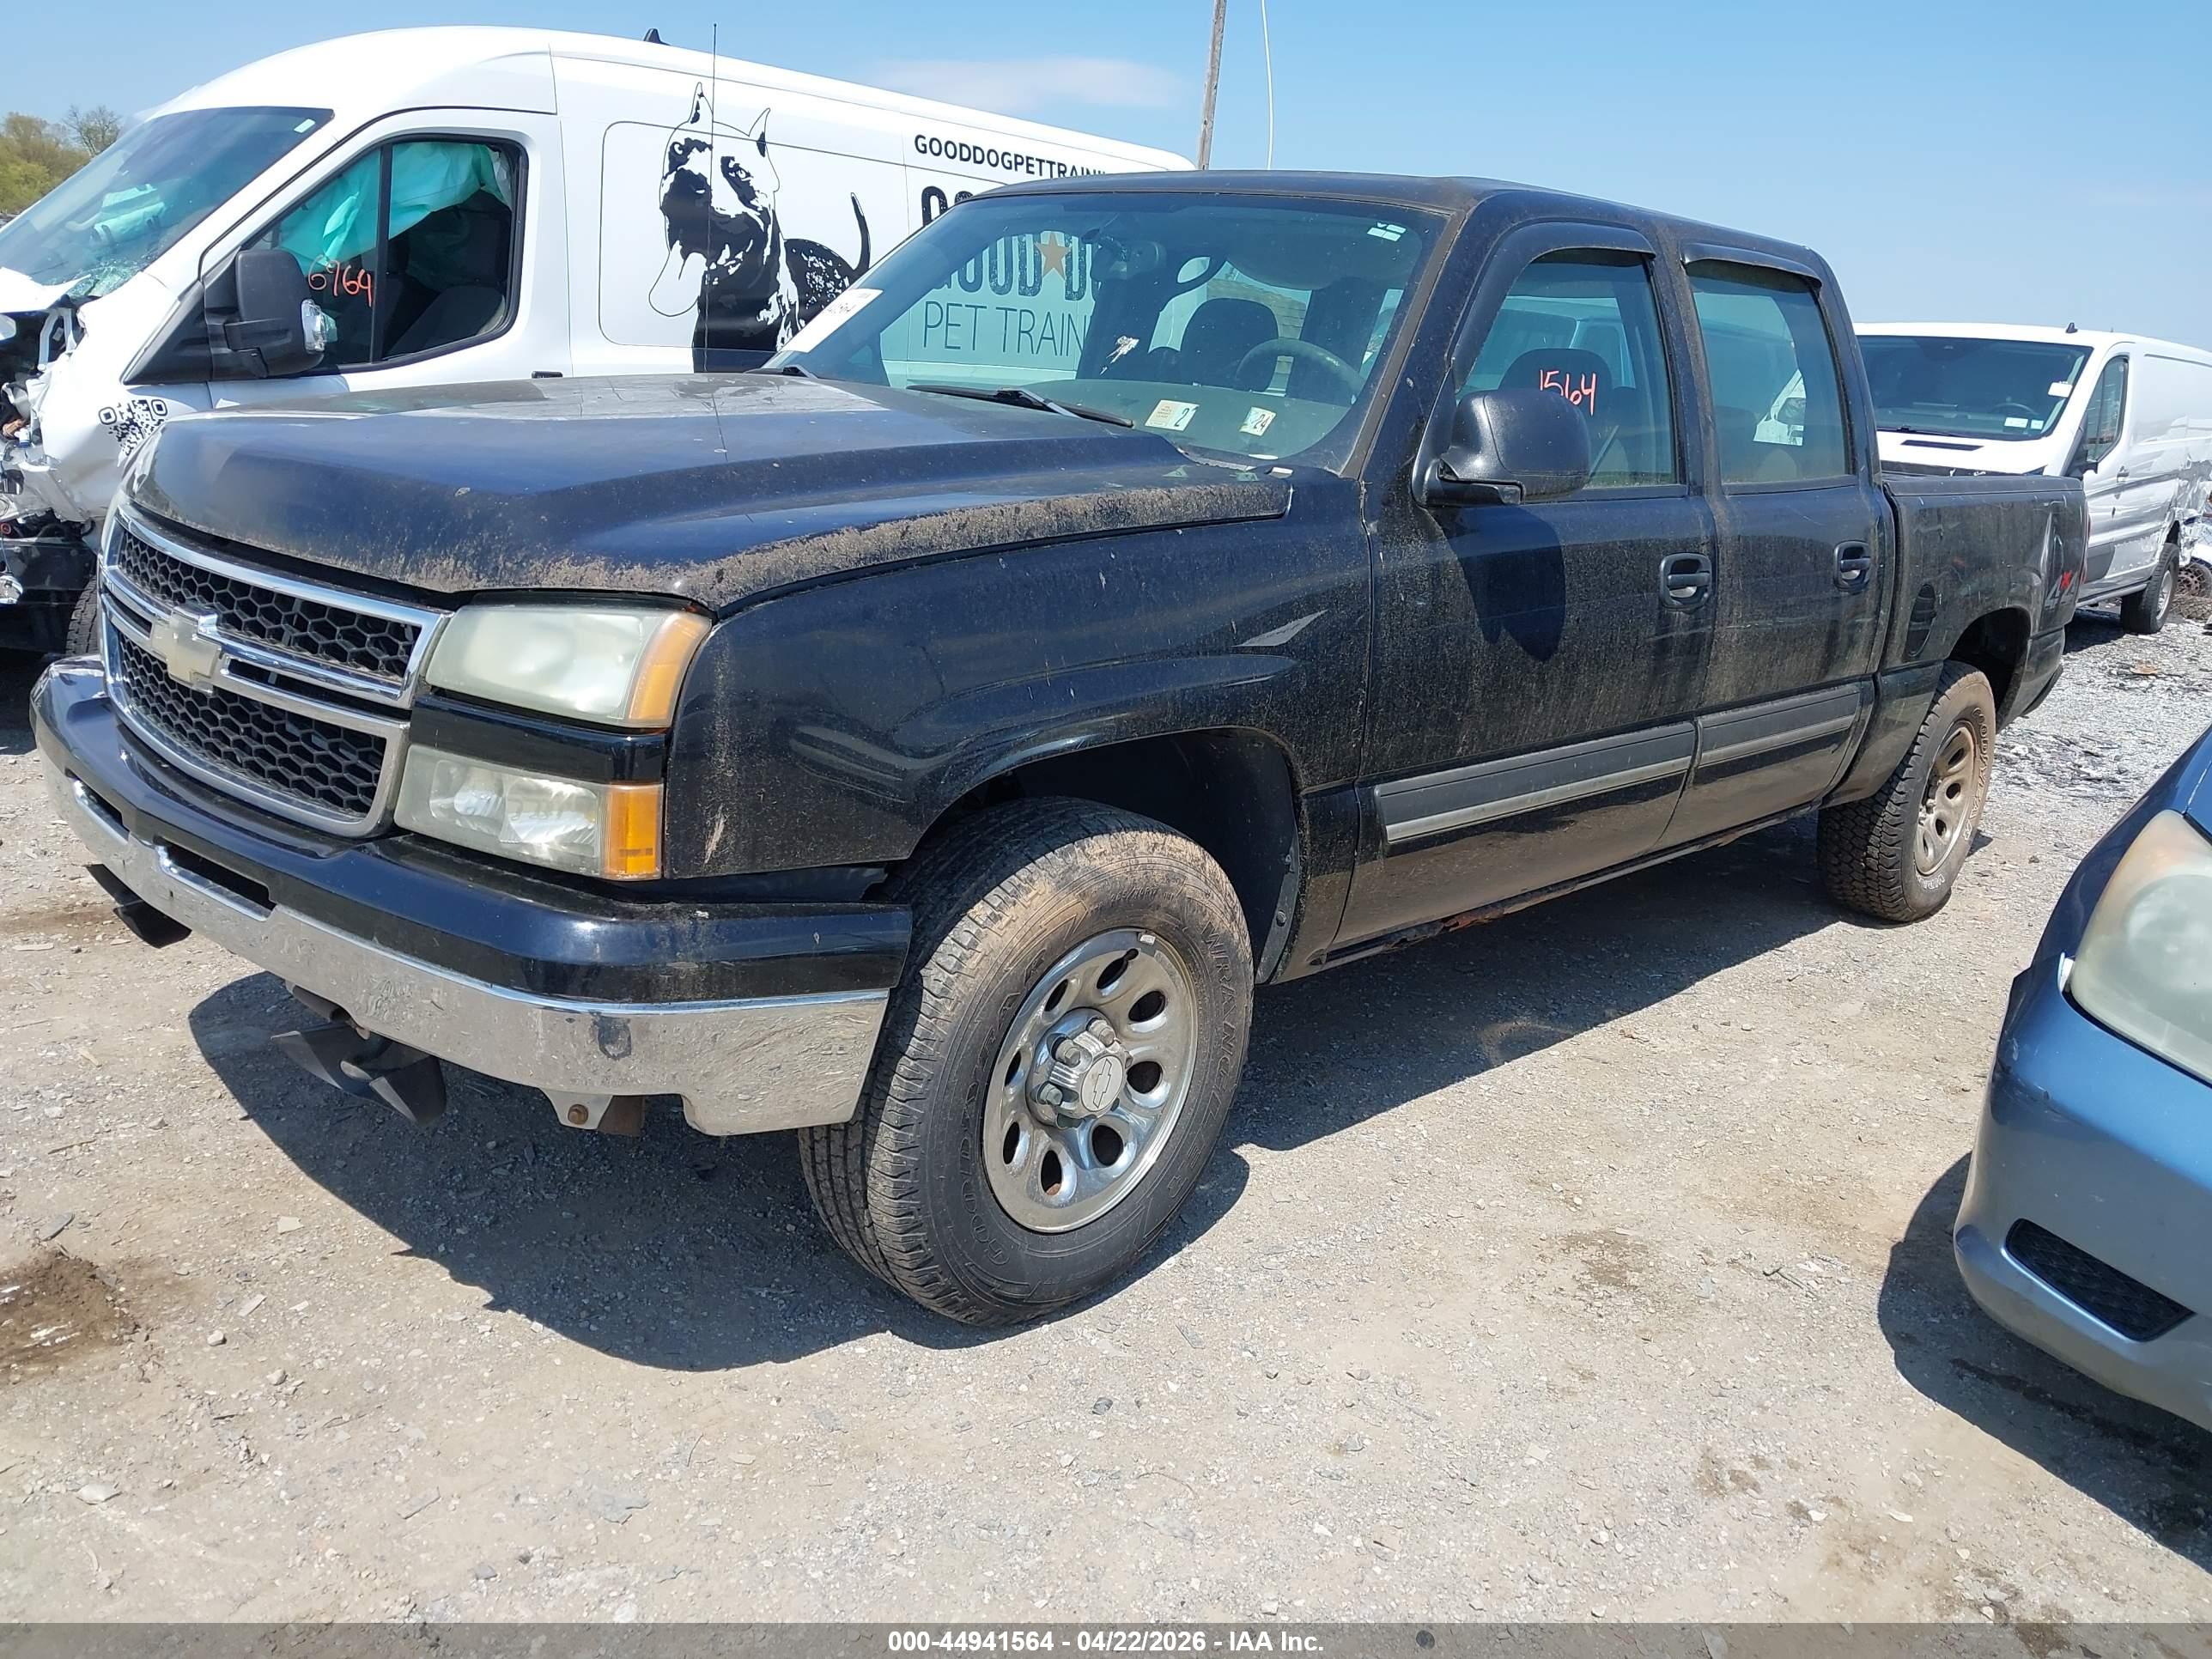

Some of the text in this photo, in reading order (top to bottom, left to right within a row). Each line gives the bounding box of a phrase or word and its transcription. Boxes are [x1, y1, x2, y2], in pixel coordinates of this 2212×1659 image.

[924, 301, 1088, 356] PET TRAIN
[1540, 369, 1596, 416] 1564
